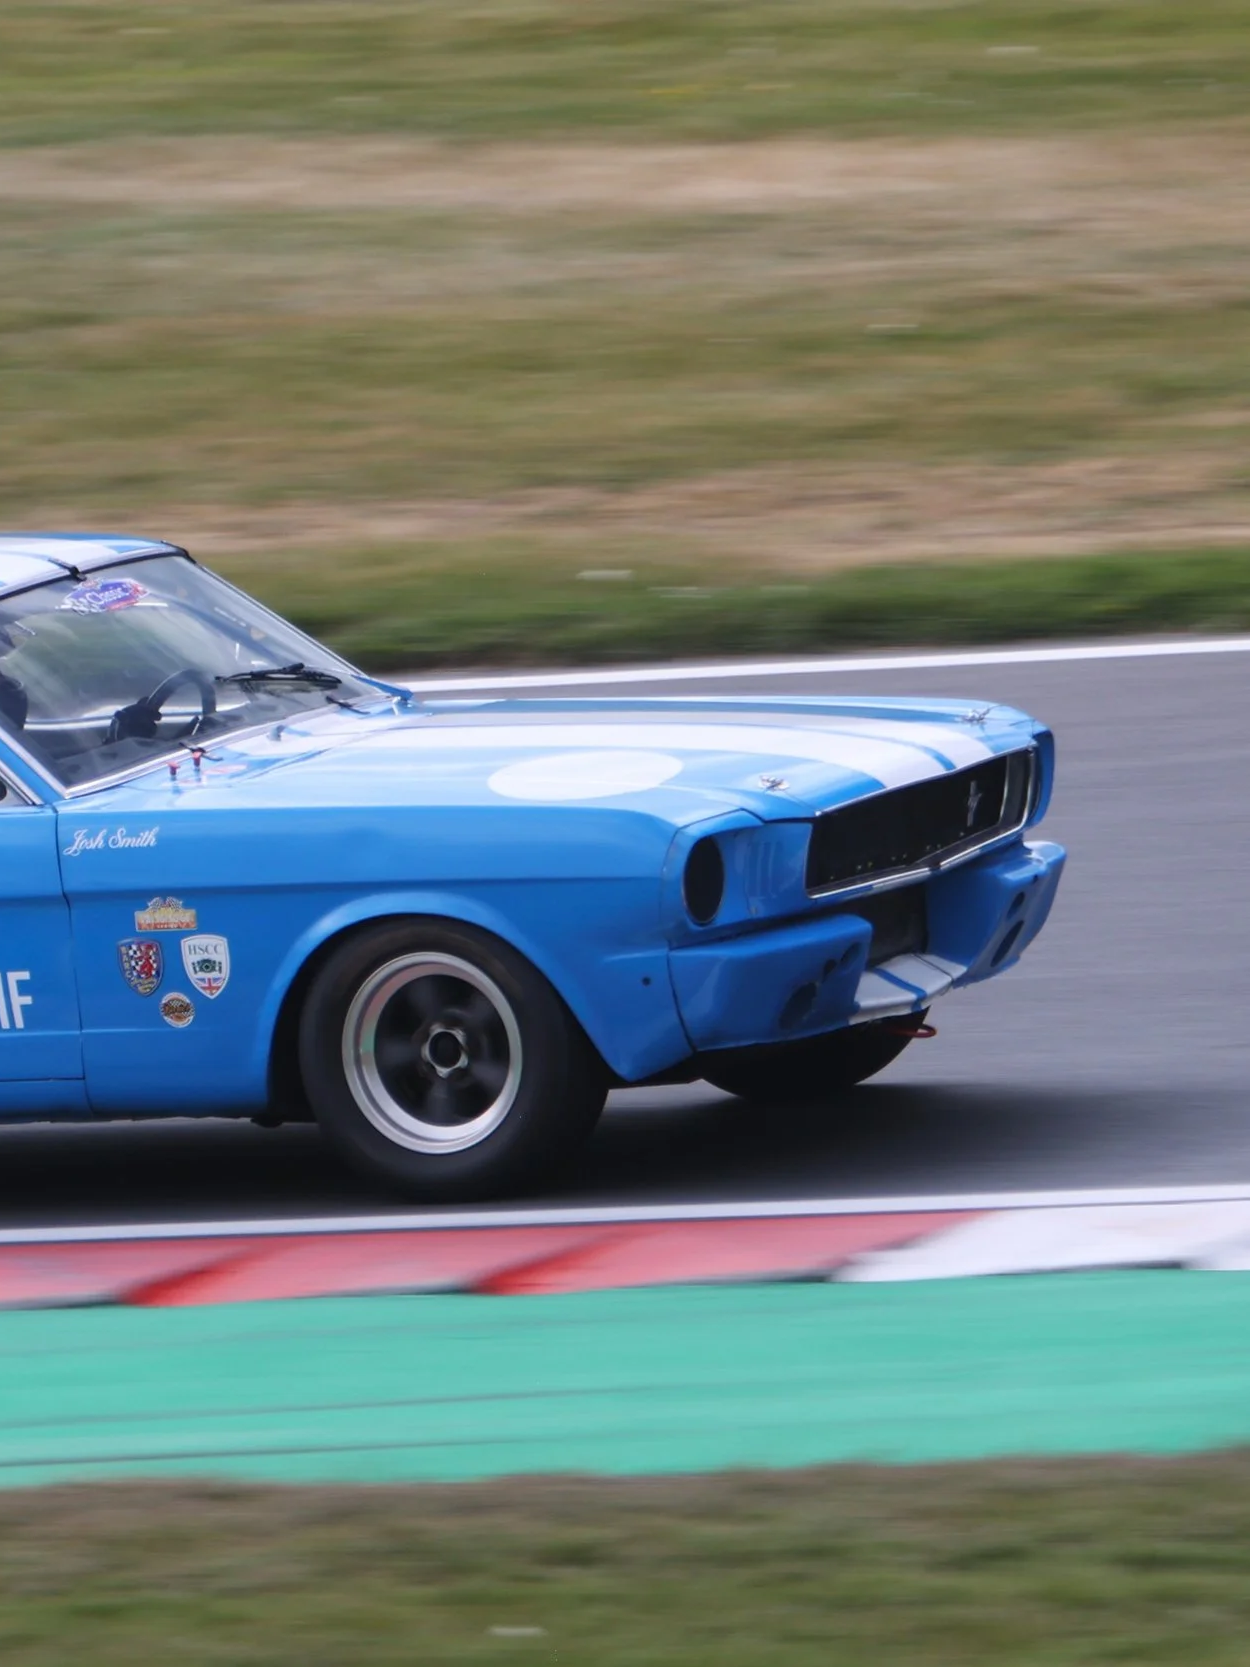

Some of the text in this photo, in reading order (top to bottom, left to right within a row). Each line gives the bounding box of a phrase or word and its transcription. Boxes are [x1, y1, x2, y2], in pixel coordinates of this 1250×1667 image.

[62, 826, 160, 857] Josh Smith
[188, 943, 222, 955] HSCC
